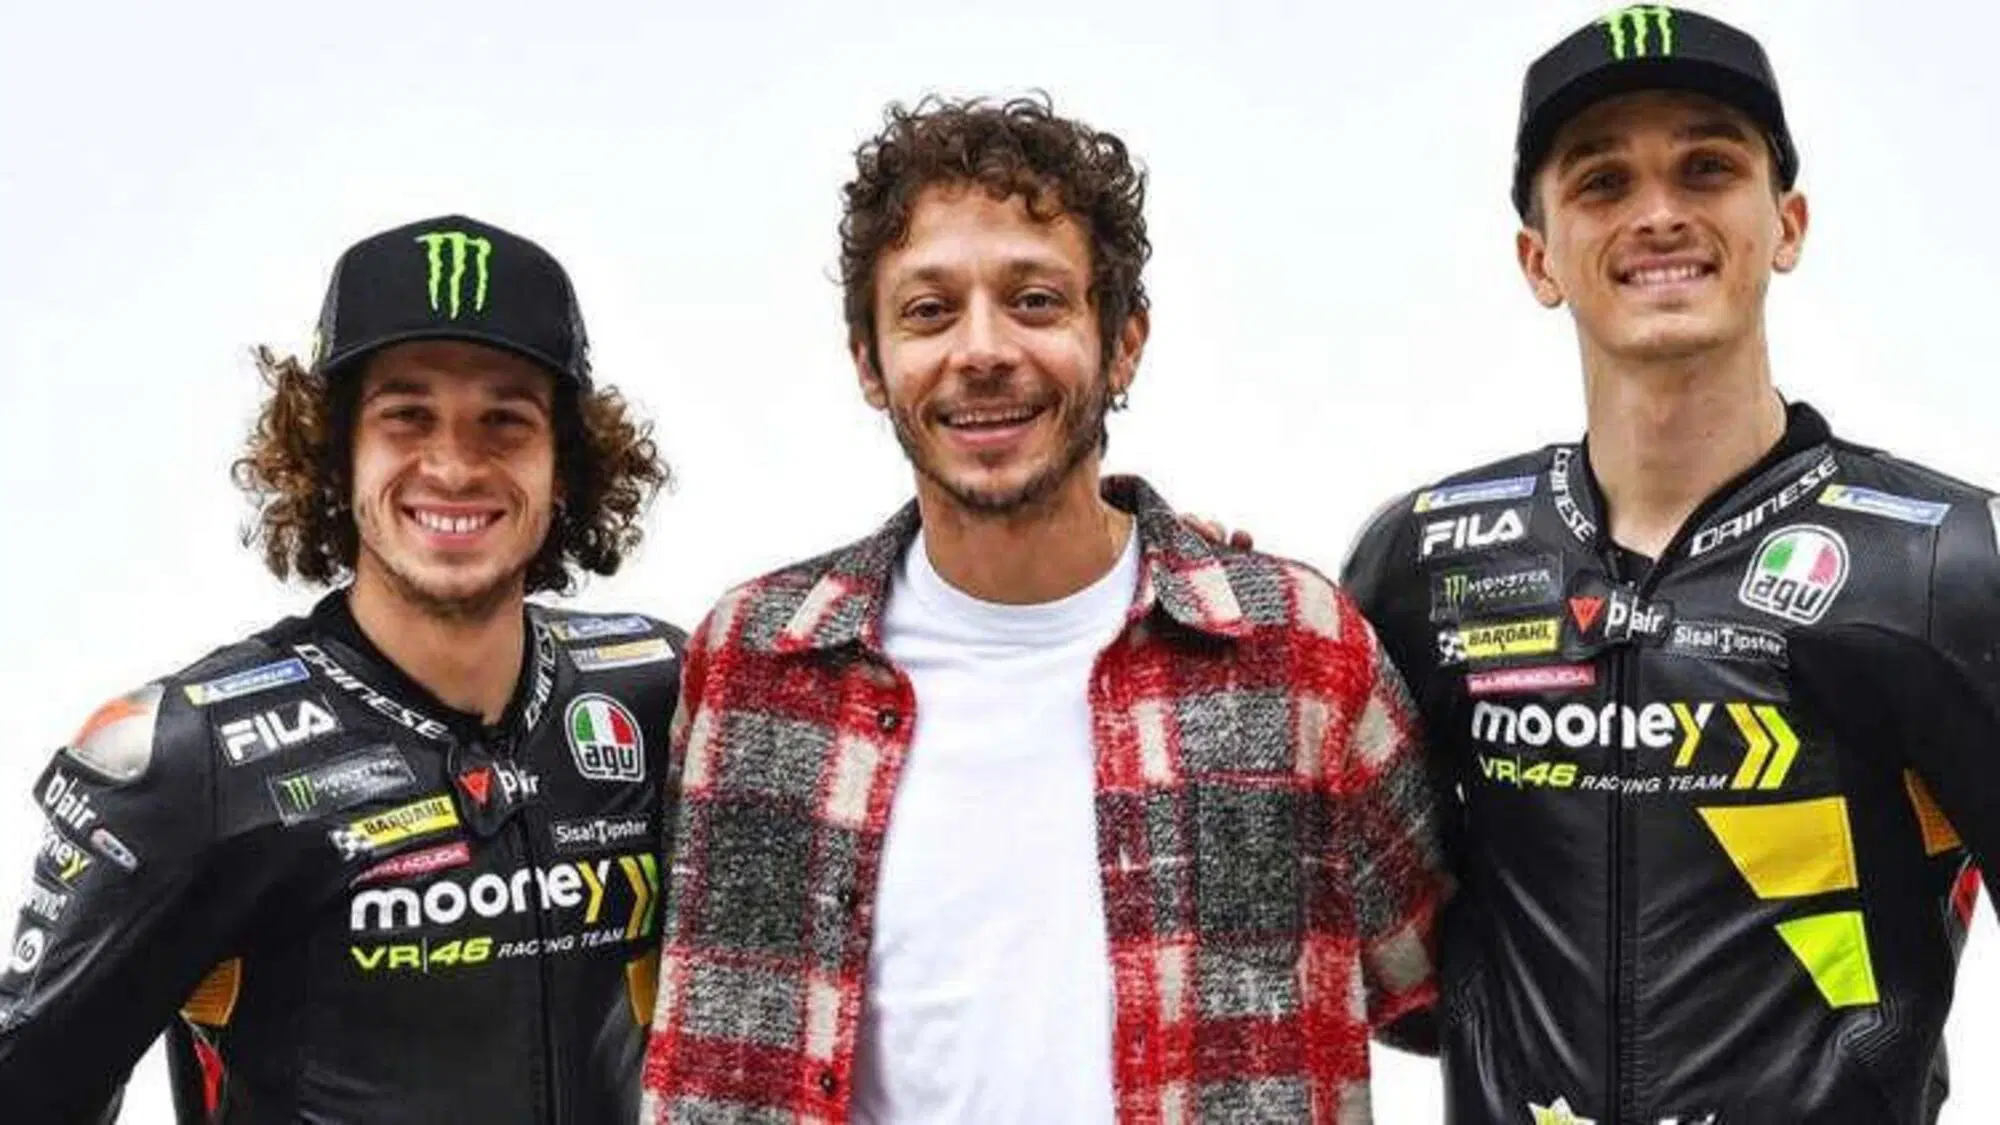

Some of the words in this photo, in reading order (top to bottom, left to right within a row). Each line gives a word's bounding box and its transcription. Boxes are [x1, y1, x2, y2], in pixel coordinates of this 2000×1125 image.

[1689, 454, 1840, 557] DAINESE
[1423, 508, 1525, 556] FILA
[1467, 568, 1551, 593] MONSTER
[1751, 575, 1824, 612] agv
[1468, 621, 1553, 651] BARDAHL
[293, 643, 449, 740] DAINESE
[221, 699, 335, 761] FILA
[1471, 700, 1715, 768] mooney
[1667, 773, 1728, 791] TEAM
[350, 859, 612, 931] mooney
[580, 927, 627, 947] TEAM
